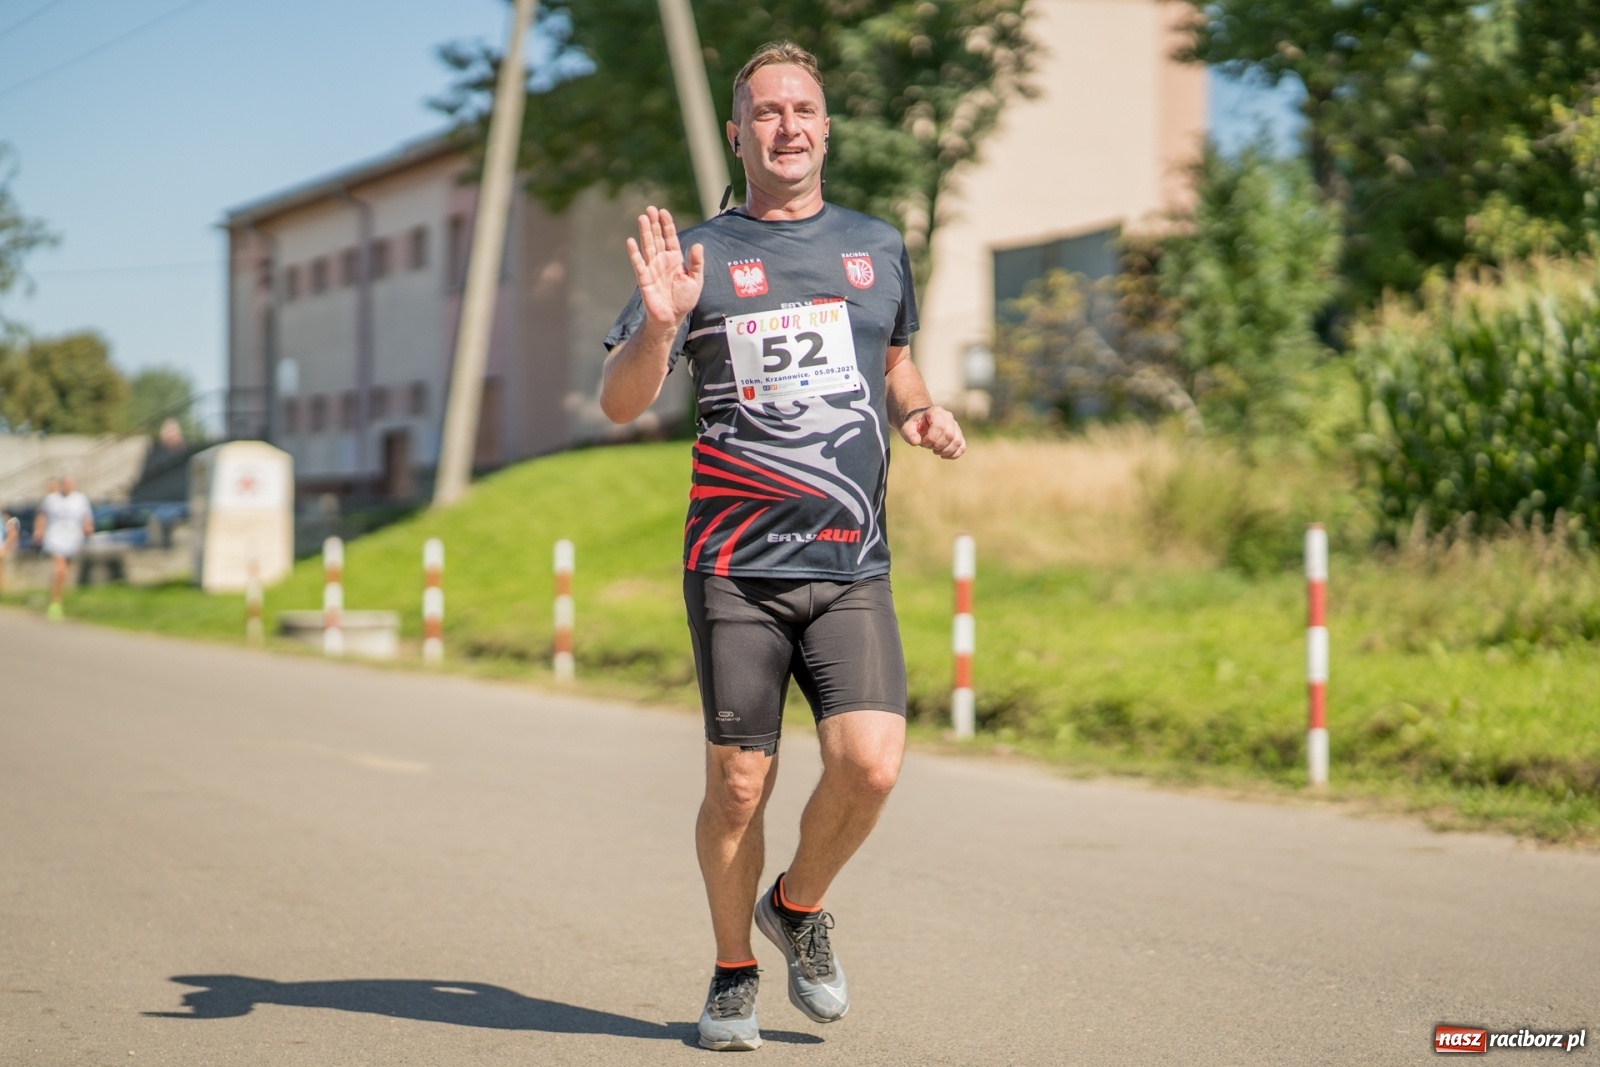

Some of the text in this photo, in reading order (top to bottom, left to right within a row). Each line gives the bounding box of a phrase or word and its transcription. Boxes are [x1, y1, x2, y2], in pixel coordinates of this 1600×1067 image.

[727, 257, 762, 267] POLSKA
[736, 309, 840, 336] COLOUR RUN
[762, 331, 828, 373] 52
[765, 371, 811, 383] Krzanowice,
[814, 365, 854, 376] 05.09.2021
